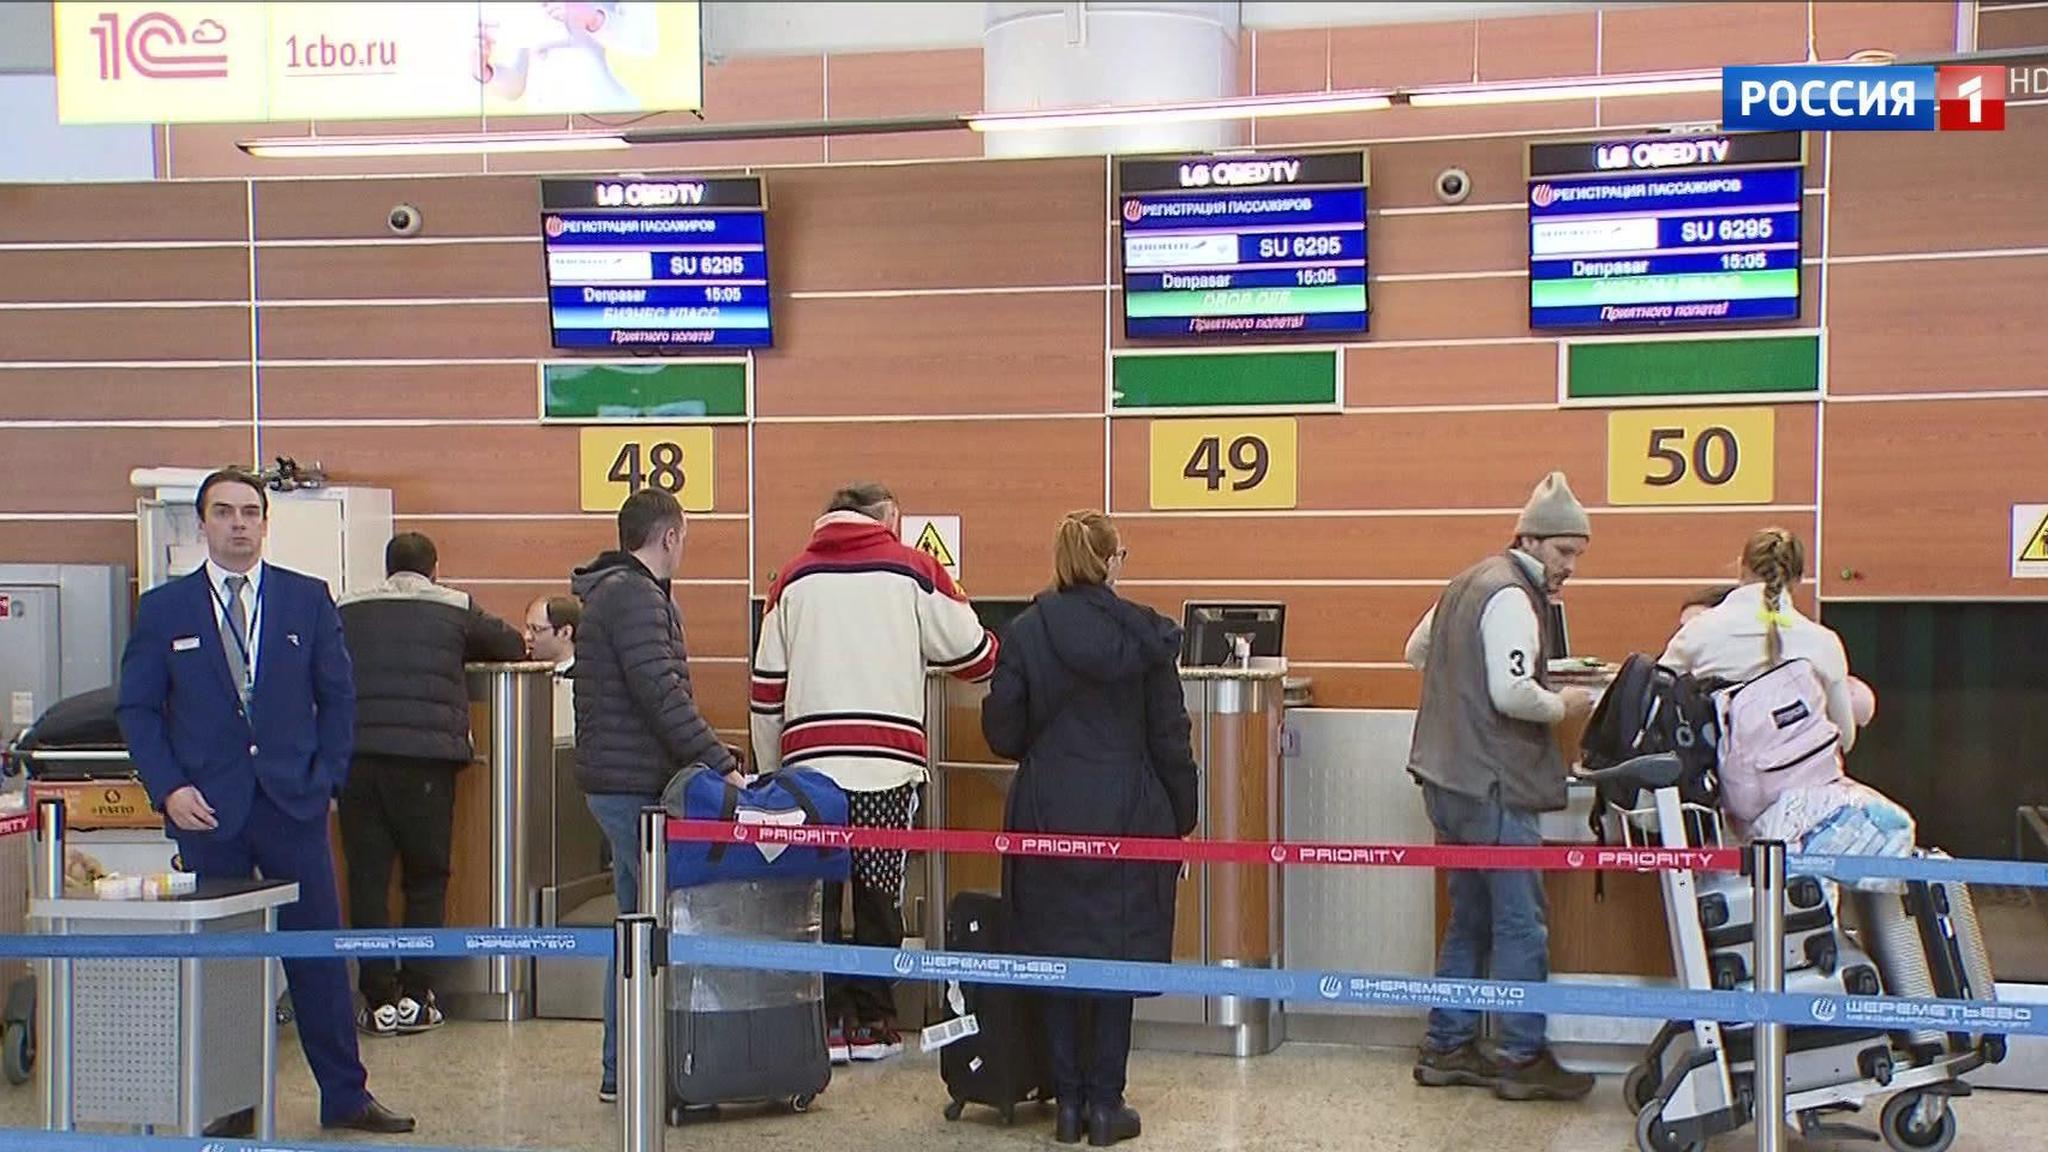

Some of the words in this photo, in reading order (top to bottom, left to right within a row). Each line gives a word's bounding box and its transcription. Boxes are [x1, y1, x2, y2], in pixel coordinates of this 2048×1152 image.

[286, 34, 396, 67] 1cbo.ru
[1553, 183, 1646, 202] РЕГИСТРАЦИЯ
[1648, 179, 1742, 197] ПАССАЖИРОВ
[1143, 201, 1226, 217] РЕГИСТРАЦИЯ
[1228, 198, 1313, 214] ПАССАЖИРОВ
[563, 220, 639, 234] РЕГИСТРАЦИЯ
[1682, 221, 1714, 242] SU
[1719, 218, 1773, 240] 6295
[1259, 238, 1289, 258] SU
[1293, 236, 1342, 257] 6295
[670, 257, 697, 275] SU
[701, 256, 744, 275] 6295
[1572, 260, 1650, 278] Denpasar
[1720, 251, 1767, 270] 15:05
[1162, 273, 1232, 291] Denpasar
[1296, 268, 1337, 285] 15:05
[583, 287, 647, 304] Denpasar
[704, 287, 742, 302] 15:05
[1600, 304, 1671, 322] Приятного
[1183, 436, 1269, 491] 49
[1644, 427, 1739, 486] 50
[607, 442, 686, 495] 48
[1510, 649, 1525, 677] 3
[759, 828, 853, 844] PRIORITY
[1021, 838, 1121, 856] PRIORITY
[1300, 847, 1406, 864] PRIORITY
[1598, 851, 1714, 868] PRIORITY
[921, 955, 1067, 974] ШЕРЕМЕТЬЕВО
[1350, 978, 1525, 998] SHEREMETYEVO
[1846, 1000, 2032, 1021] ШЕРЕМЕТЬЕВО
